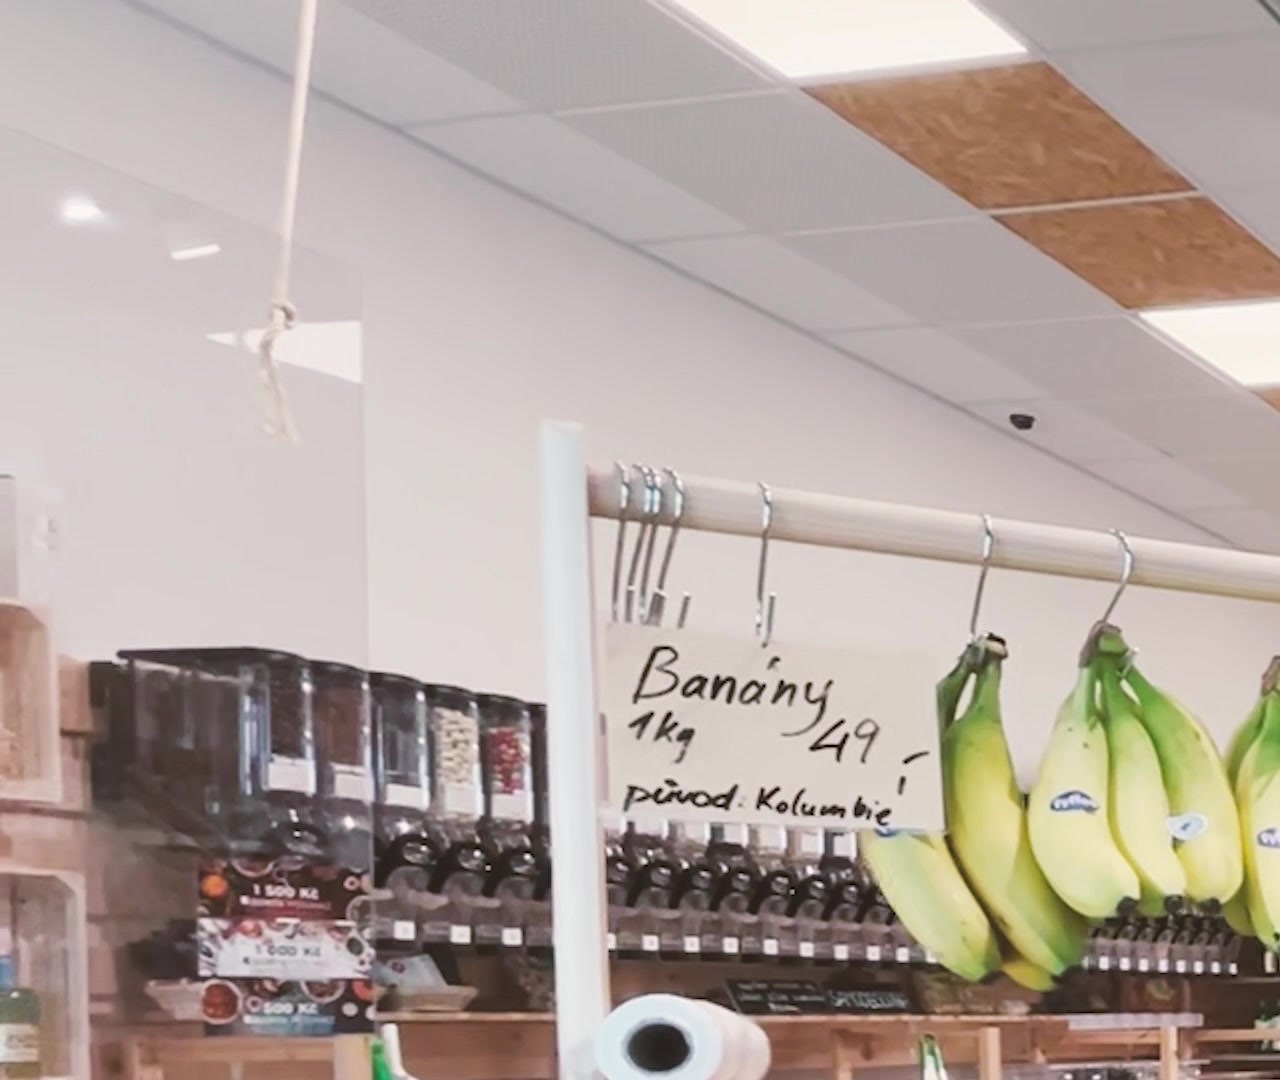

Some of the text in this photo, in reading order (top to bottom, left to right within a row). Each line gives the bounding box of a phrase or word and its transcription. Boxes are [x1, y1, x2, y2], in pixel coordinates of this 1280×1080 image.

[632, 645, 834, 738] Banány
[628, 711, 696, 764] 1kg
[756, 786, 893, 827] Kolumbie
